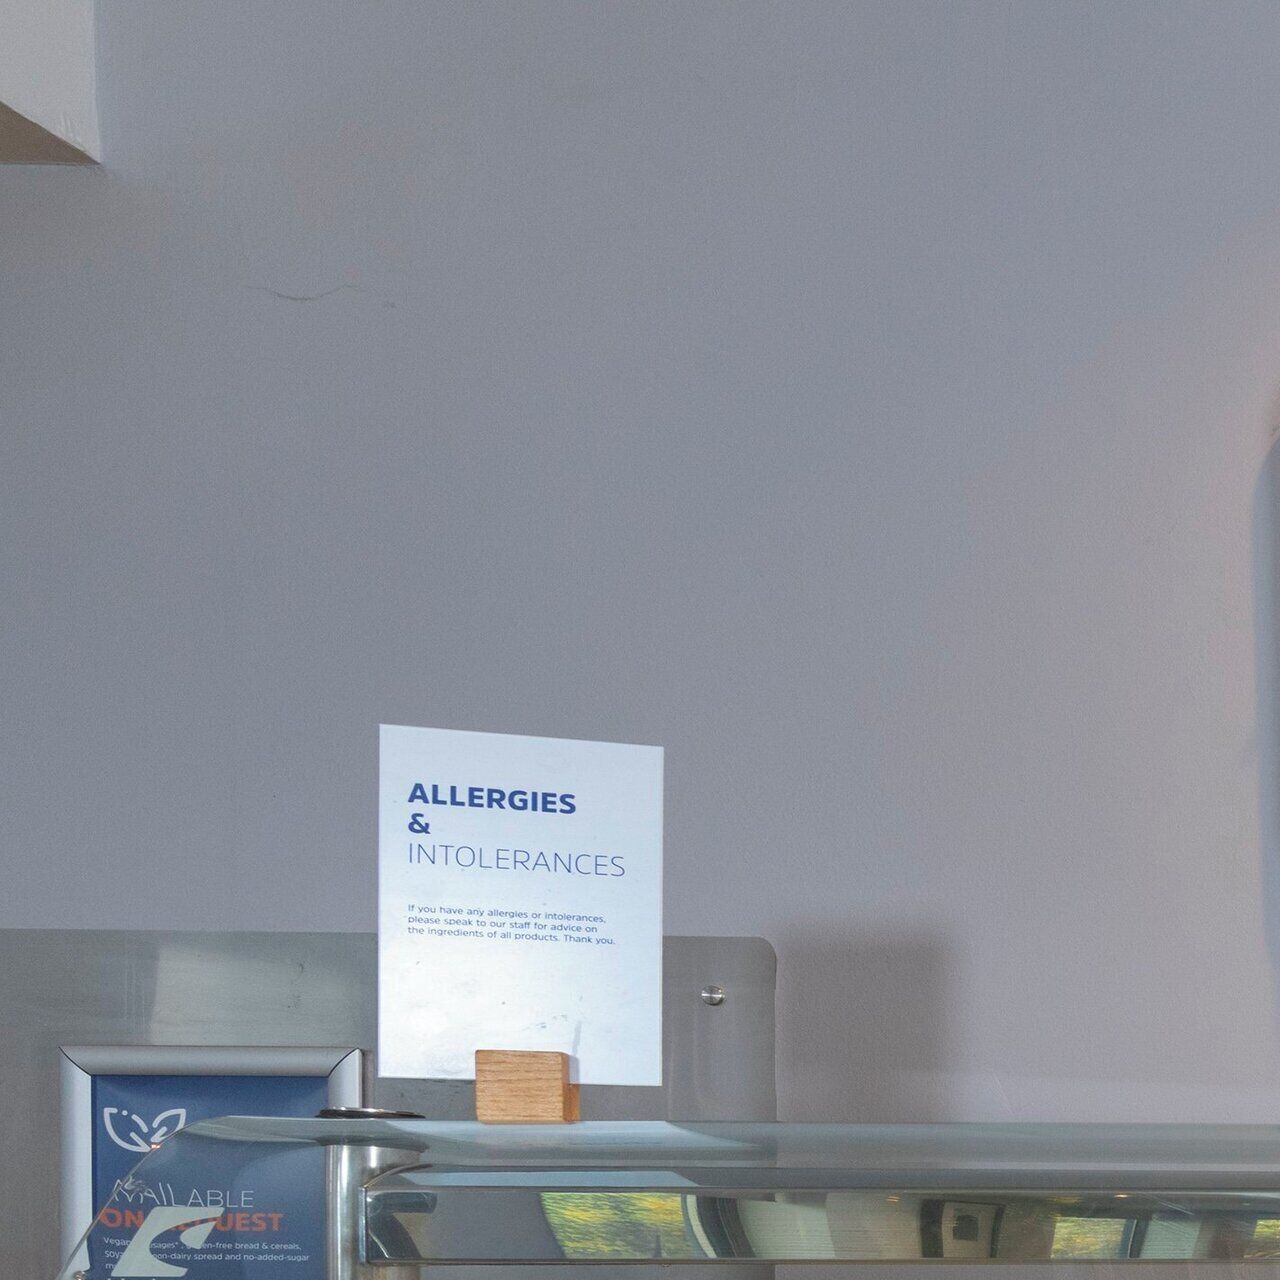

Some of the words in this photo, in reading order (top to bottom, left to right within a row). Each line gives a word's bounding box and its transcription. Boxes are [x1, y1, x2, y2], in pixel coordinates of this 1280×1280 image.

[407, 782, 577, 814] ALLERGIES
[407, 812, 431, 835] &
[408, 842, 626, 878] INTOLERANCES
[407, 915, 441, 926] please
[443, 917, 473, 928] speak
[476, 919, 487, 927] to
[489, 920, 506, 928] our
[509, 921, 531, 929] staff
[533, 922, 547, 930] for
[550, 922, 582, 932] advice
[585, 925, 598, 933] on
[408, 904, 415, 912] If
[417, 905, 436, 914] you
[439, 906, 463, 915] have
[466, 907, 485, 917] any
[487, 908, 529, 920] allergies
[531, 911, 542, 919] or
[544, 911, 607, 924] intolerances,
[407, 926, 424, 935] the
[427, 926, 484, 938] ingredients
[486, 930, 498, 938] of
[500, 931, 512, 939] all
[514, 932, 560, 942] products.
[564, 934, 592, 943] Thank
[595, 936, 616, 945] you.
[100, 1207, 145, 1229] ON
[235, 1242, 260, 1250] bread
[193, 1253, 223, 1262] spread
[243, 1253, 309, 1262] no-added-sugar
